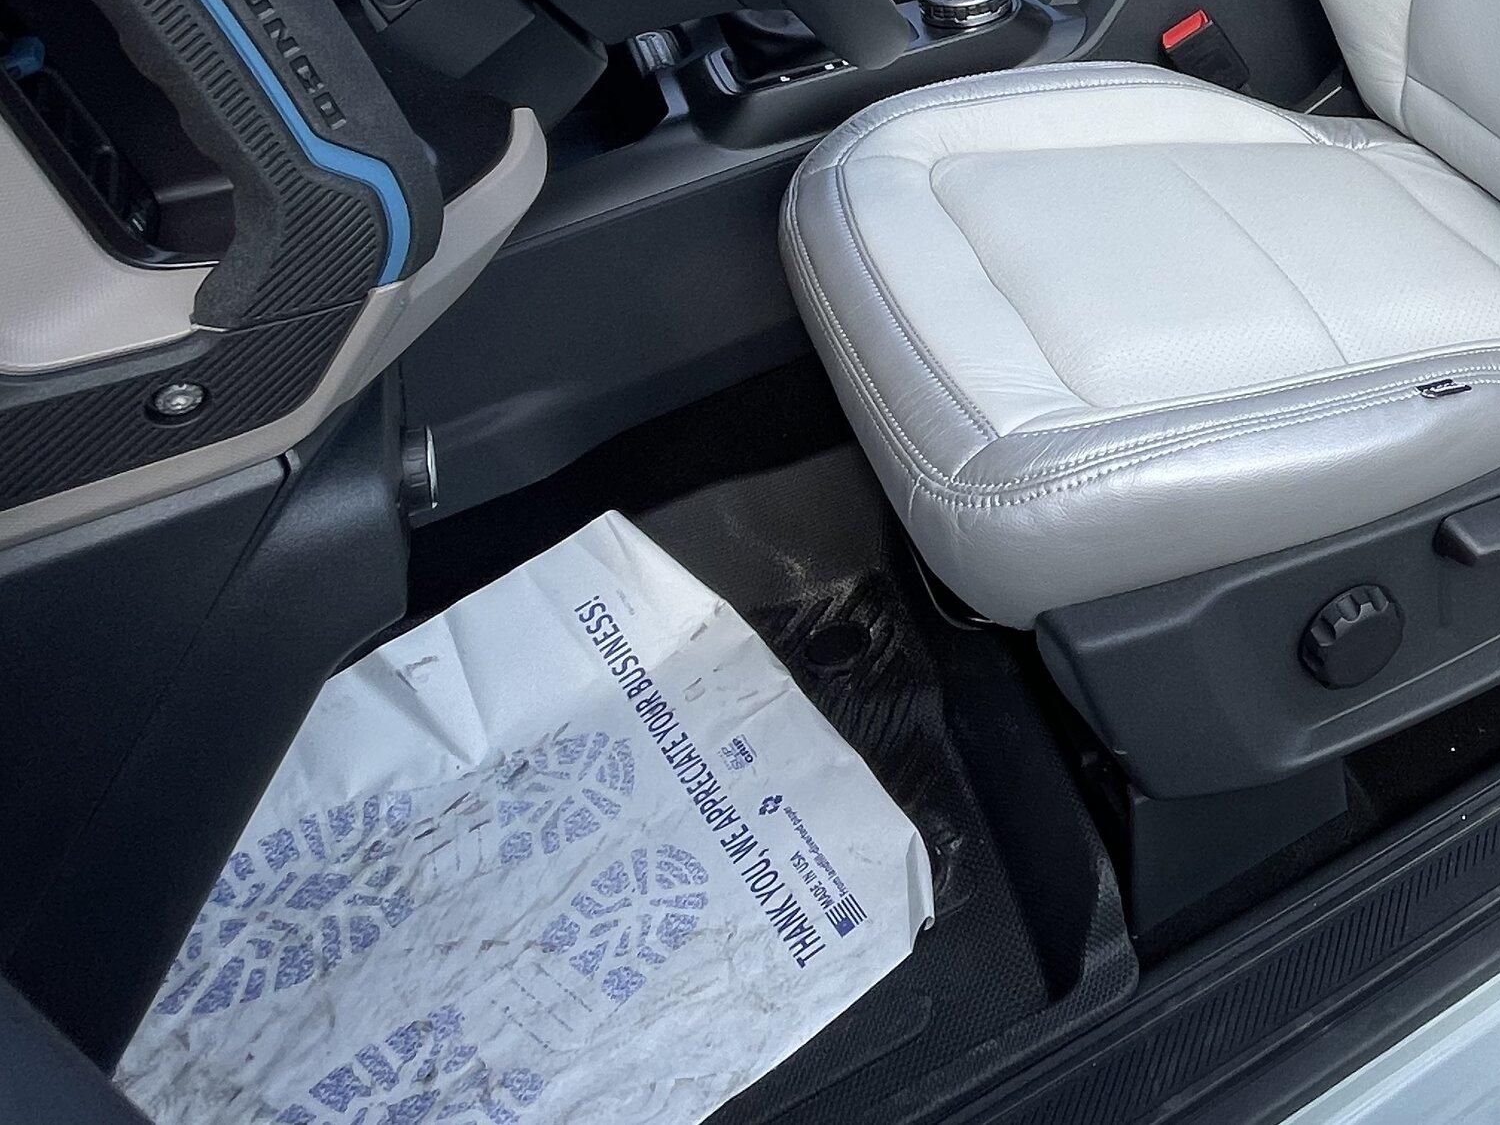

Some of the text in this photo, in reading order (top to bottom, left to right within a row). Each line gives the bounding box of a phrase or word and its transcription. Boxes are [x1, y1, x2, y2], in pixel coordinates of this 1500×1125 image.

[574, 596, 653, 700] BUSINESS!
[636, 690, 679, 743] YOUR
[720, 744, 743, 771] SLIP
[732, 736, 754, 764] GRIP
[661, 732, 741, 831] APPRECIATE
[720, 824, 758, 864] WE
[783, 807, 849, 897] From landfill-diverted paper
[741, 848, 785, 906] YOU,
[790, 851, 834, 910] MADE IN USA
[766, 893, 825, 968] THANK
